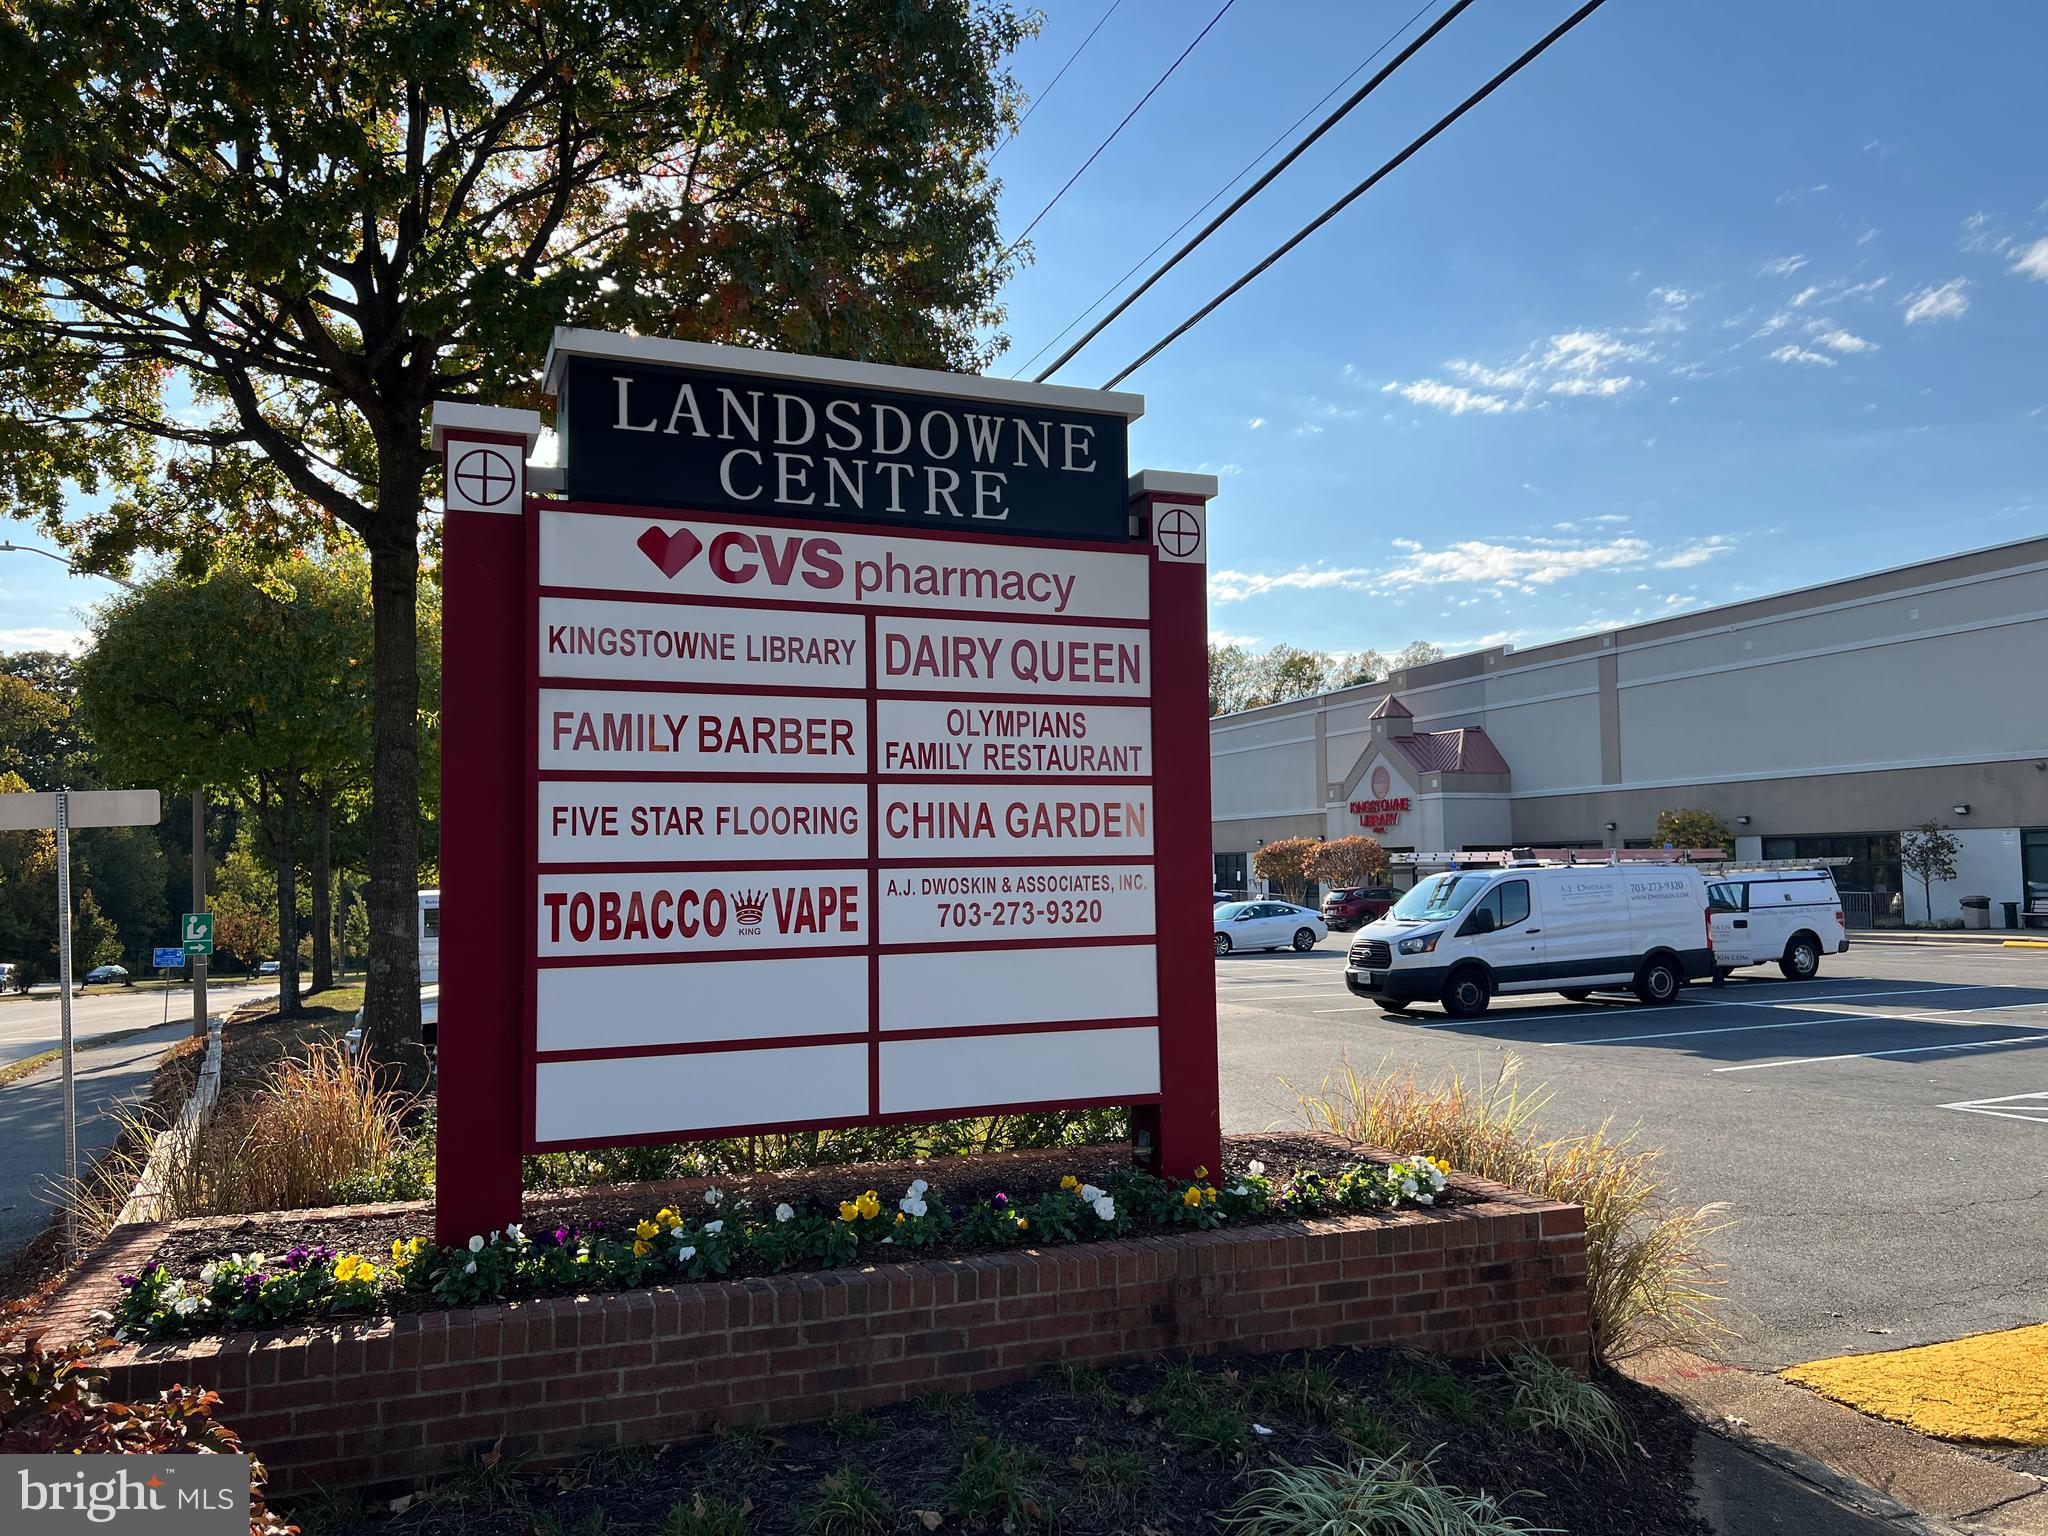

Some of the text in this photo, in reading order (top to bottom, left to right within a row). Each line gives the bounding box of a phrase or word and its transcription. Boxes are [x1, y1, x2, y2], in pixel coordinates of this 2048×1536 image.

[612, 375, 1099, 473] LANDSDOWNE
[719, 448, 1010, 521] CENTRE
[708, 530, 1076, 612] CVS pharmacy
[548, 624, 857, 666] KINGSTOWNE LIBRARY
[885, 632, 1141, 685] DAIRY QUEEN
[553, 711, 856, 756] FAMILY BARBER
[946, 708, 1087, 739] OLYMPIANS
[885, 741, 1143, 772] FAMILY RESTAURANT
[552, 805, 858, 837] FIVE STAR FLOORING
[885, 801, 1145, 840] CHINA GARDEN
[887, 873, 1148, 897] A.J. DWOSKIN & ASSOCIATES, INC.
[1630, 881, 1684, 893] 703-273-9320
[543, 885, 859, 943] TOBACCO VAPE
[738, 927, 761, 936] KING
[937, 899, 1102, 928] 703-273-9320
